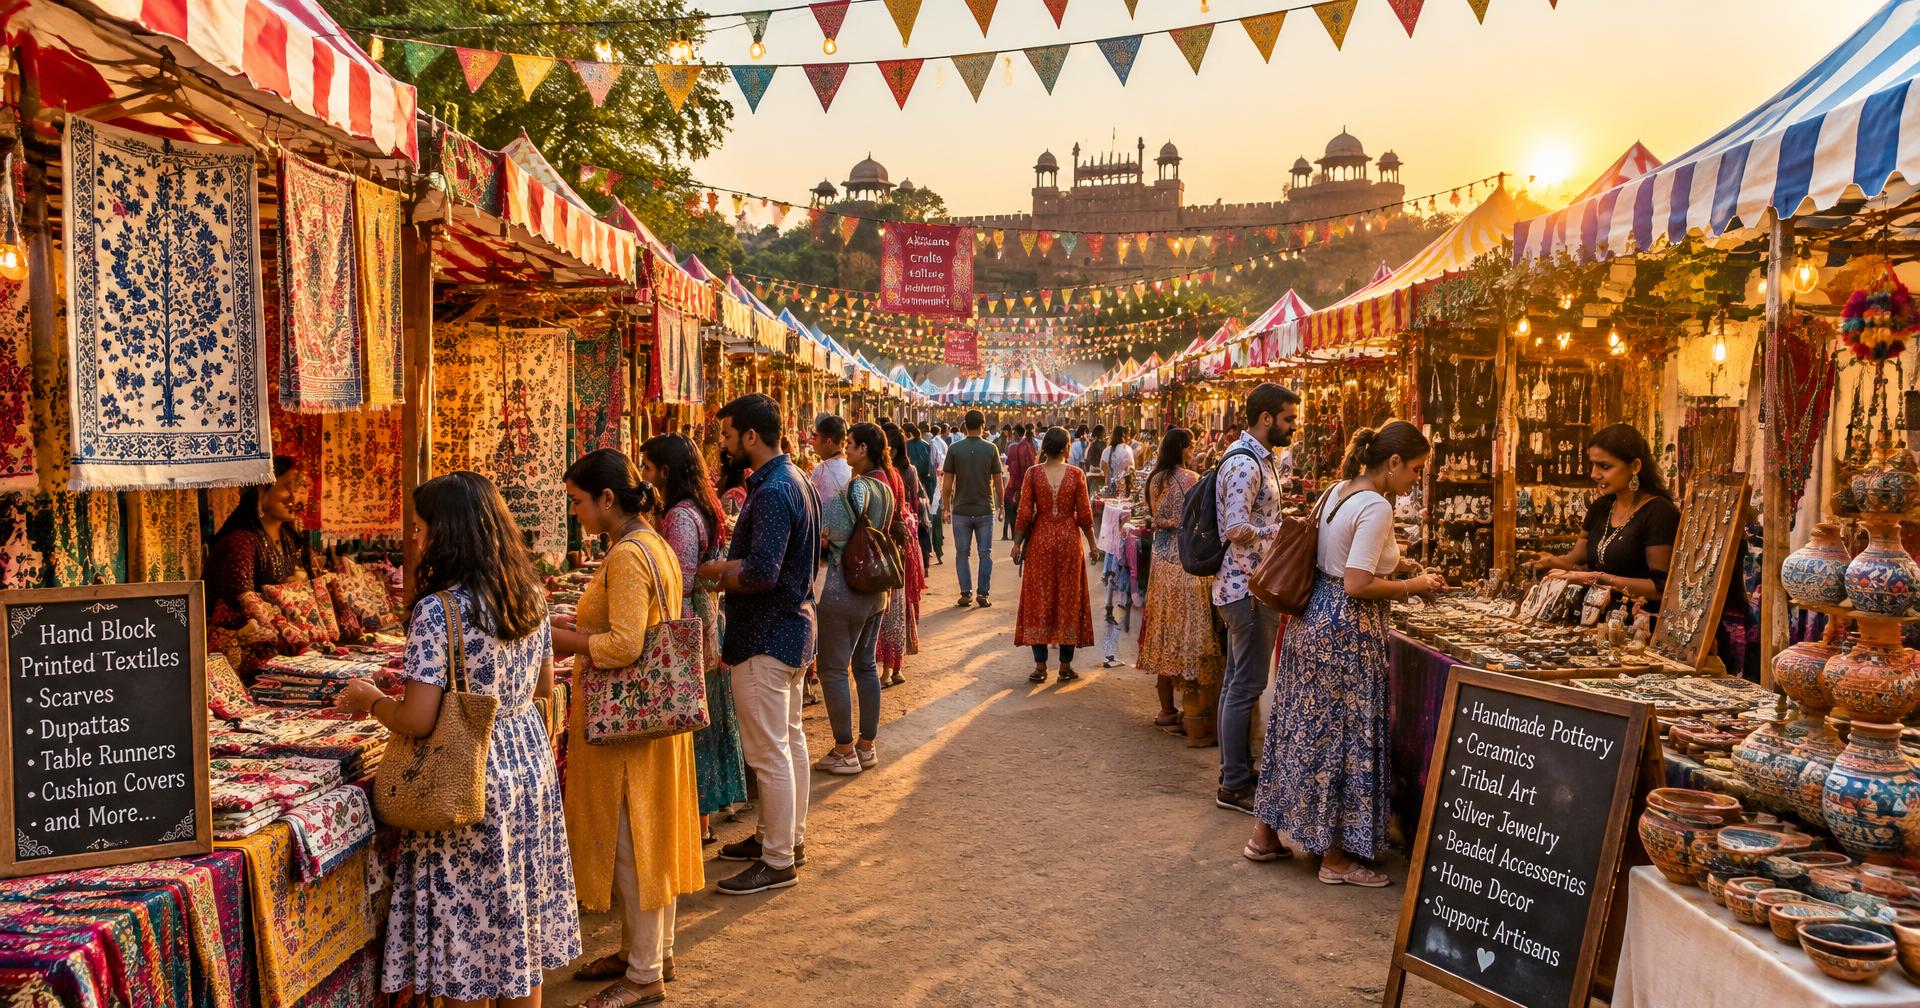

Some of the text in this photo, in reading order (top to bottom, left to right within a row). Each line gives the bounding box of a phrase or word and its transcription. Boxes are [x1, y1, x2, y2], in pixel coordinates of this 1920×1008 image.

[40, 618, 156, 645] Hand Block
[21, 648, 179, 678] Printed Textiles
[40, 688, 113, 708] Scarves
[41, 716, 129, 743] Dupattas
[1471, 702, 1614, 760] Handmade Pottery
[41, 744, 175, 770] Table Runners
[1466, 733, 1535, 769] Ceramics
[42, 773, 185, 801] Cushion Covers
[1461, 765, 1537, 805] Tribal Art
[45, 805, 156, 832] and More...
[1452, 798, 1559, 855] Silver Jewelry
[1446, 830, 1497, 864] Beaded
[1440, 863, 1534, 912] Home Decor
[1432, 896, 1560, 966] Support Artisans
